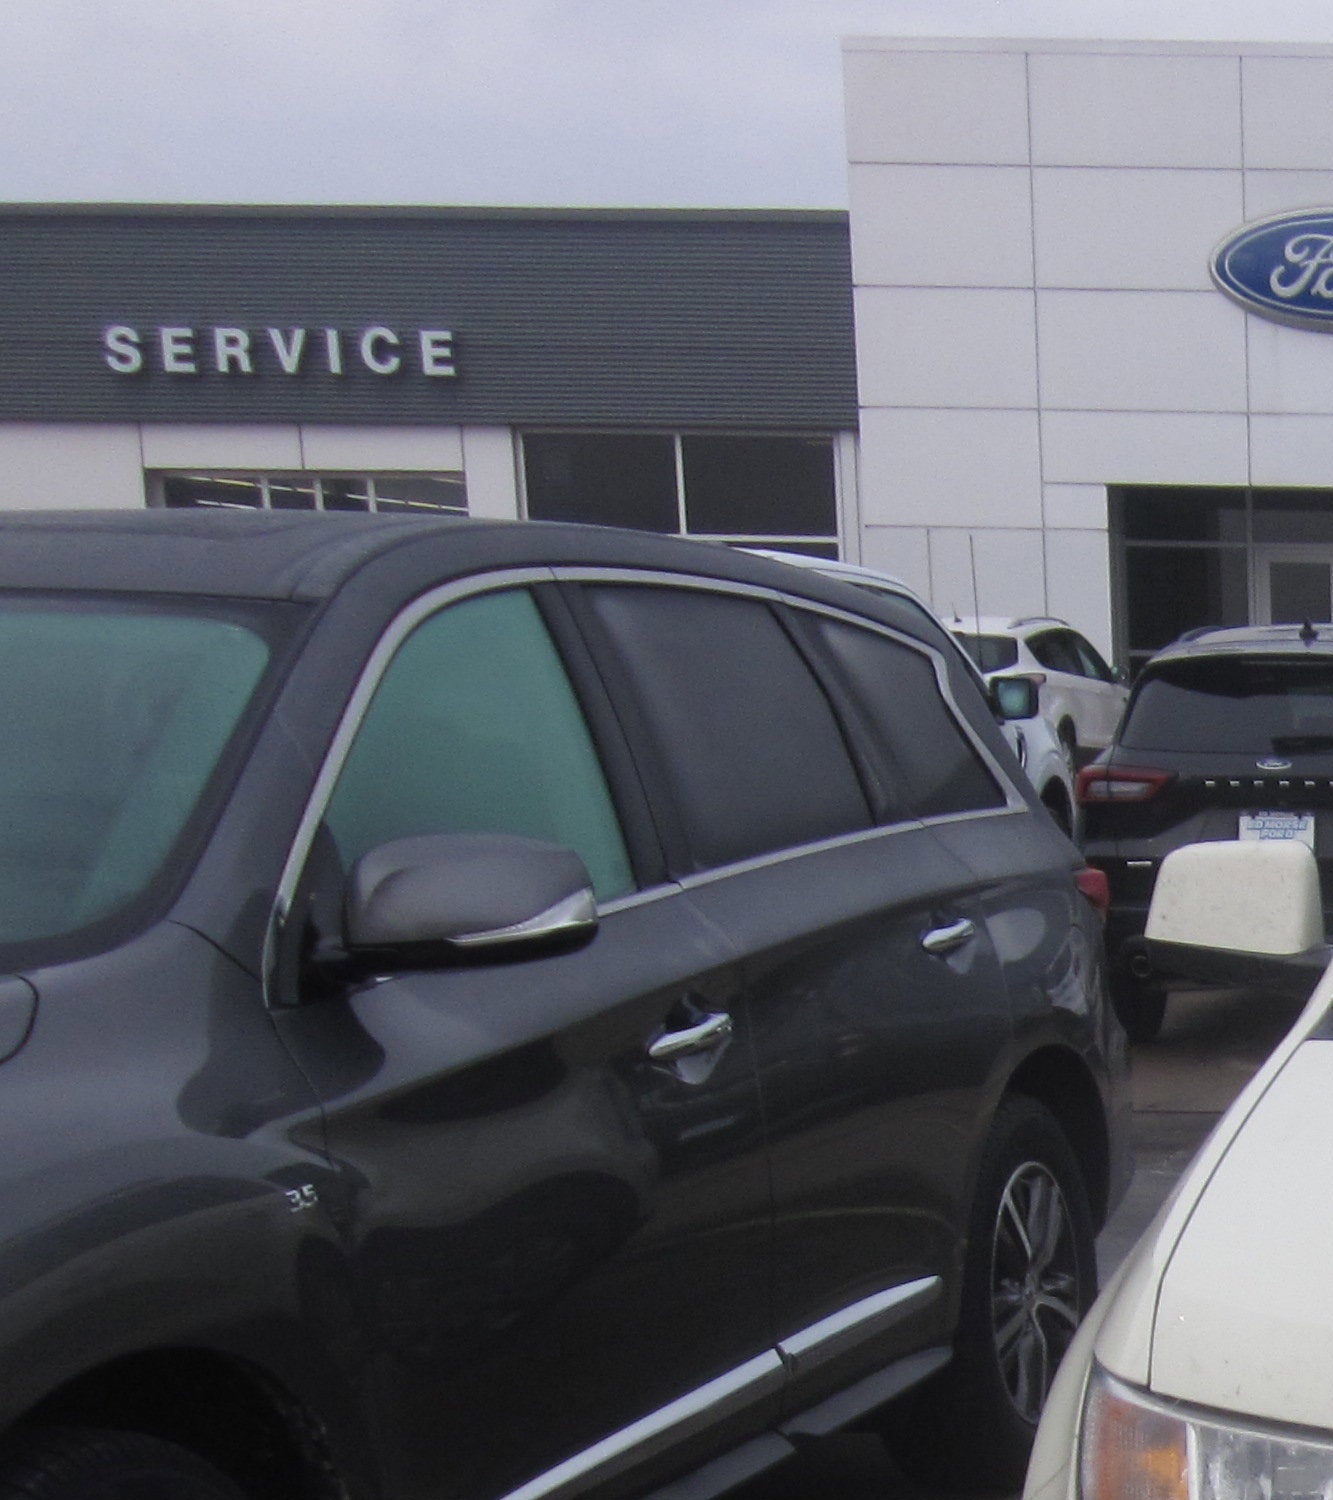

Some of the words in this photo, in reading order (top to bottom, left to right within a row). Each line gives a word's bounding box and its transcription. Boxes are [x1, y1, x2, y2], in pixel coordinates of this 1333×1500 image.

[103, 324, 457, 377] SERVICE
[1258, 829, 1296, 839] FORD
[284, 1183, 319, 1213] 35
